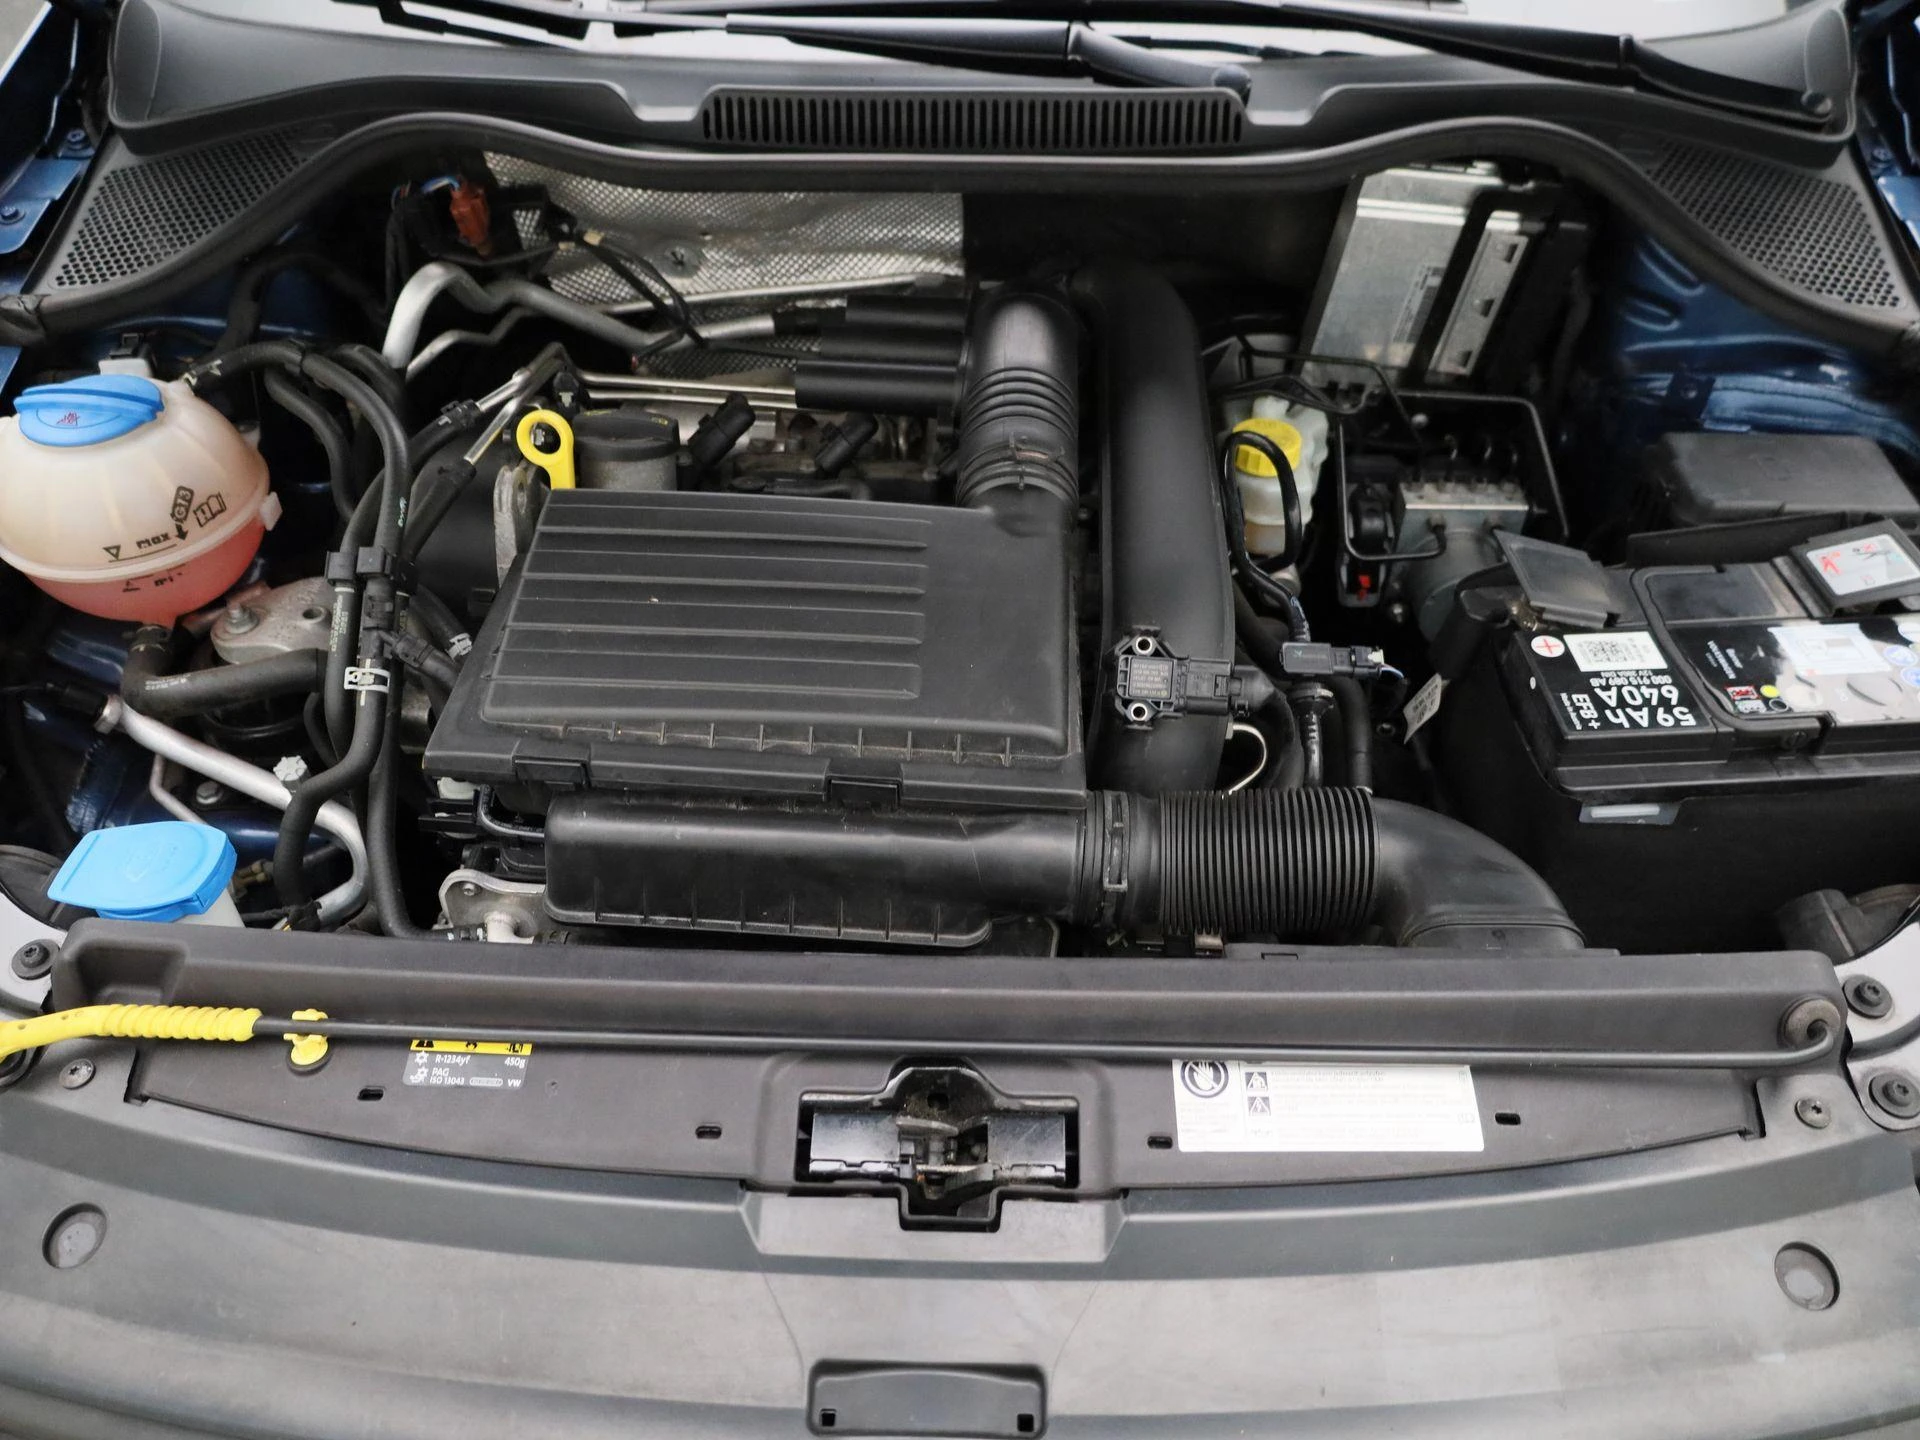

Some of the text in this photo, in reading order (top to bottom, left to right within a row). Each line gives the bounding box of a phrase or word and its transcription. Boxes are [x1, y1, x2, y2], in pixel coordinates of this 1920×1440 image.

[1629, 676, 1650, 685] 915
[1651, 675, 1672, 685] 000
[1594, 685, 1679, 708] 640A
[435, 1055, 526, 1069] R-1234yf 450g
[432, 1068, 449, 1076] PAG
[430, 1077, 443, 1085] ISO
[508, 1079, 521, 1087] VW
